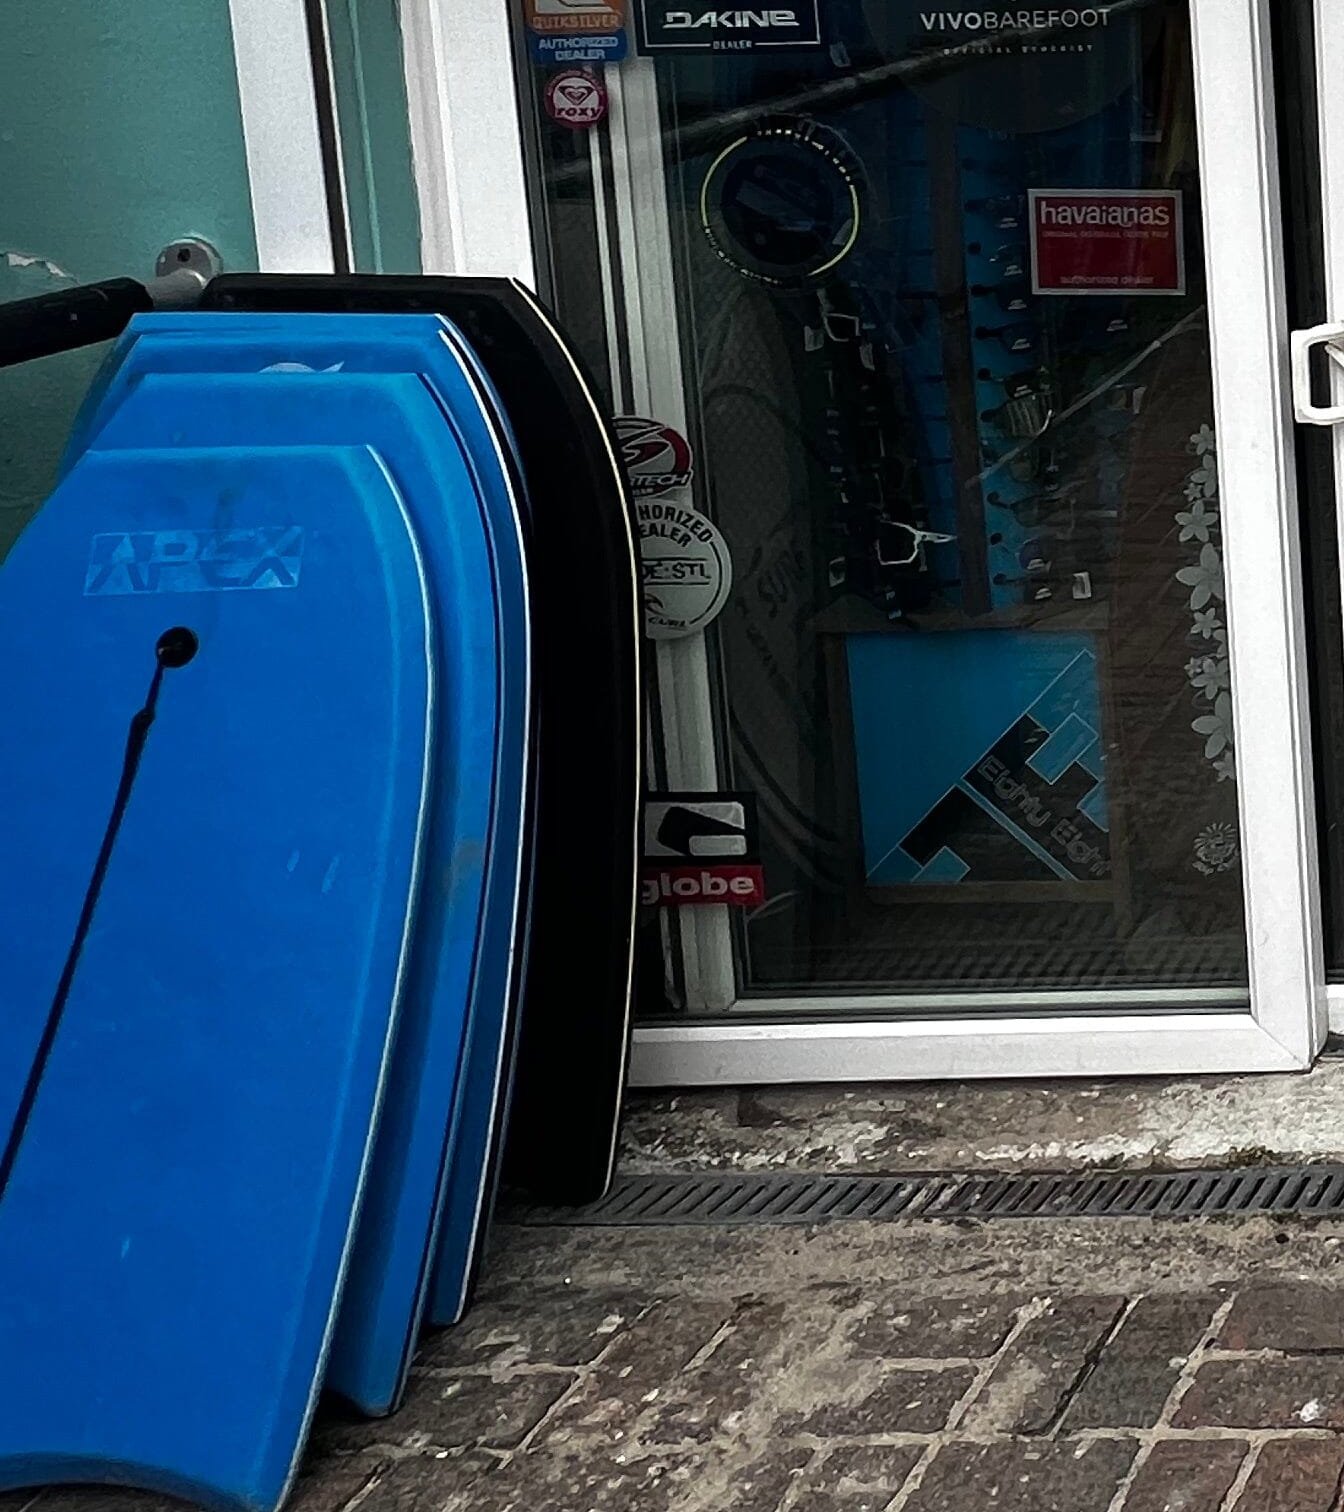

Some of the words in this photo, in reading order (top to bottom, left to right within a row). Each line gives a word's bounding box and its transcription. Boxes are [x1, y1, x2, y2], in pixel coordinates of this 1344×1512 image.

[533, 15, 620, 29] QUIKSILVER
[920, 8, 1112, 31] VIVOBAREFOOT
[538, 36, 619, 50] AUTHORIZED
[712, 40, 753, 50] DEALER
[554, 49, 606, 61] DEALER
[556, 106, 603, 119] roxy
[1040, 200, 1170, 228] havaianas
[631, 474, 690, 489] TECH
[638, 504, 713, 544] HORIZED
[639, 522, 692, 548] EALER
[84, 526, 303, 596] APEX
[641, 870, 756, 908] globe
